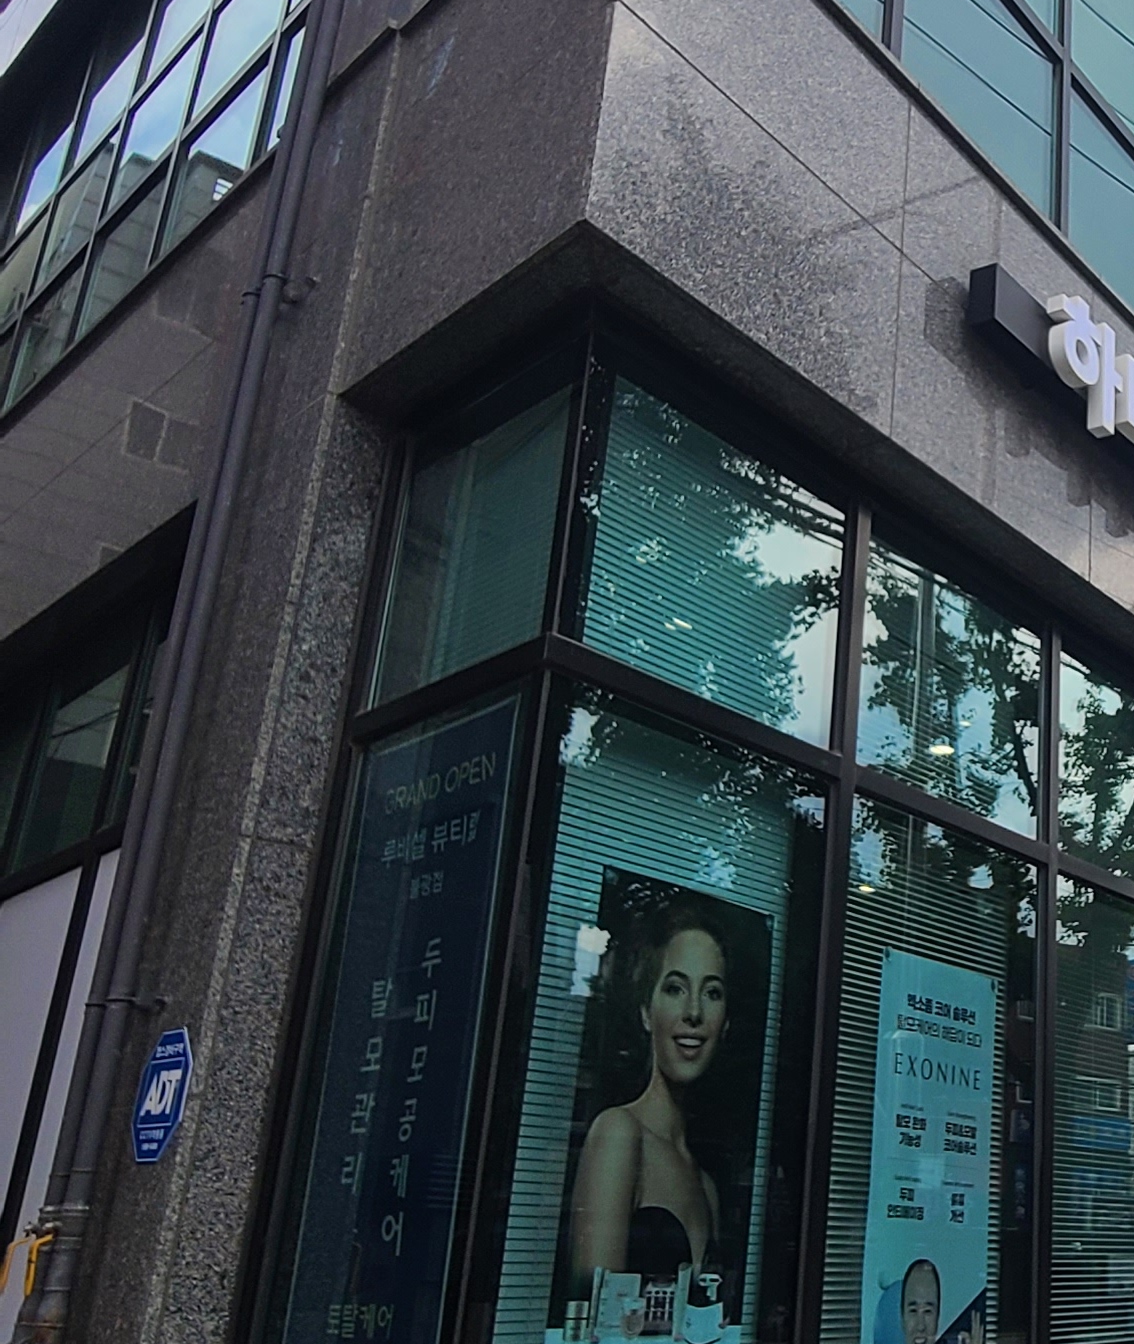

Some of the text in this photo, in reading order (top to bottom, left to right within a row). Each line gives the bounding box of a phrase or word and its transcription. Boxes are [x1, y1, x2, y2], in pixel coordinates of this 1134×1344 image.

[385, 752, 496, 815] GRAND OPEN
[381, 827, 427, 869] 루비셀
[894, 1052, 981, 1090] EXONINE
[140, 1069, 182, 1116] ADT
[327, 1304, 395, 1340] 토탈케어
